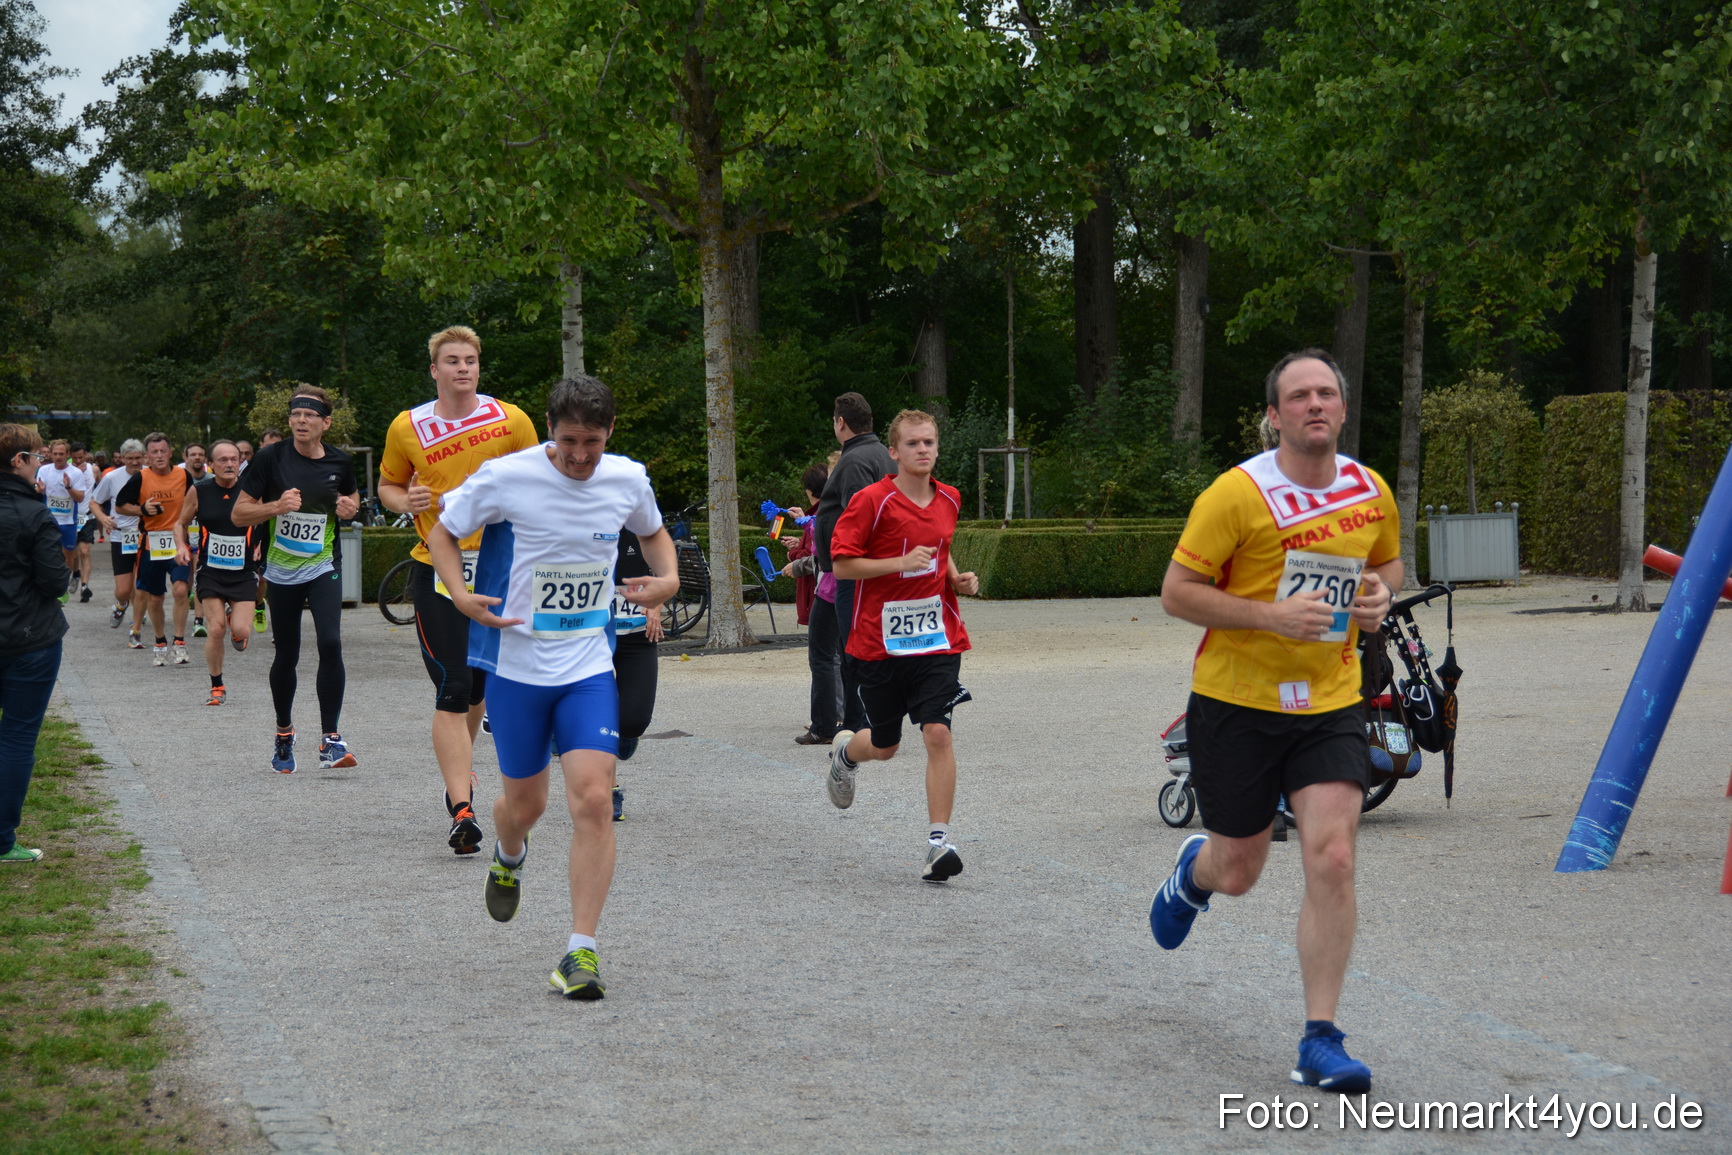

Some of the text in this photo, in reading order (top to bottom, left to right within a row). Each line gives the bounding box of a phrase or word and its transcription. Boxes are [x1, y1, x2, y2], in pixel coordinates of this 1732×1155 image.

[425, 425, 512, 466] MAX BÖGL
[51, 499, 70, 508] 2557
[280, 520, 321, 541] 3032
[1281, 506, 1386, 552] MAX BÖGL
[159, 537, 173, 549] 97
[212, 542, 242, 557] 3093
[1287, 558, 1355, 575] PARTL Neumarkt
[535, 571, 600, 579] PARTL Neumarkt
[541, 580, 604, 610] 2397
[1287, 572, 1356, 608] 2760
[883, 602, 934, 613] PARTL Neumarkt
[559, 615, 585, 628] Peter
[889, 610, 939, 636] 2573
[898, 638, 935, 648] Matthias
